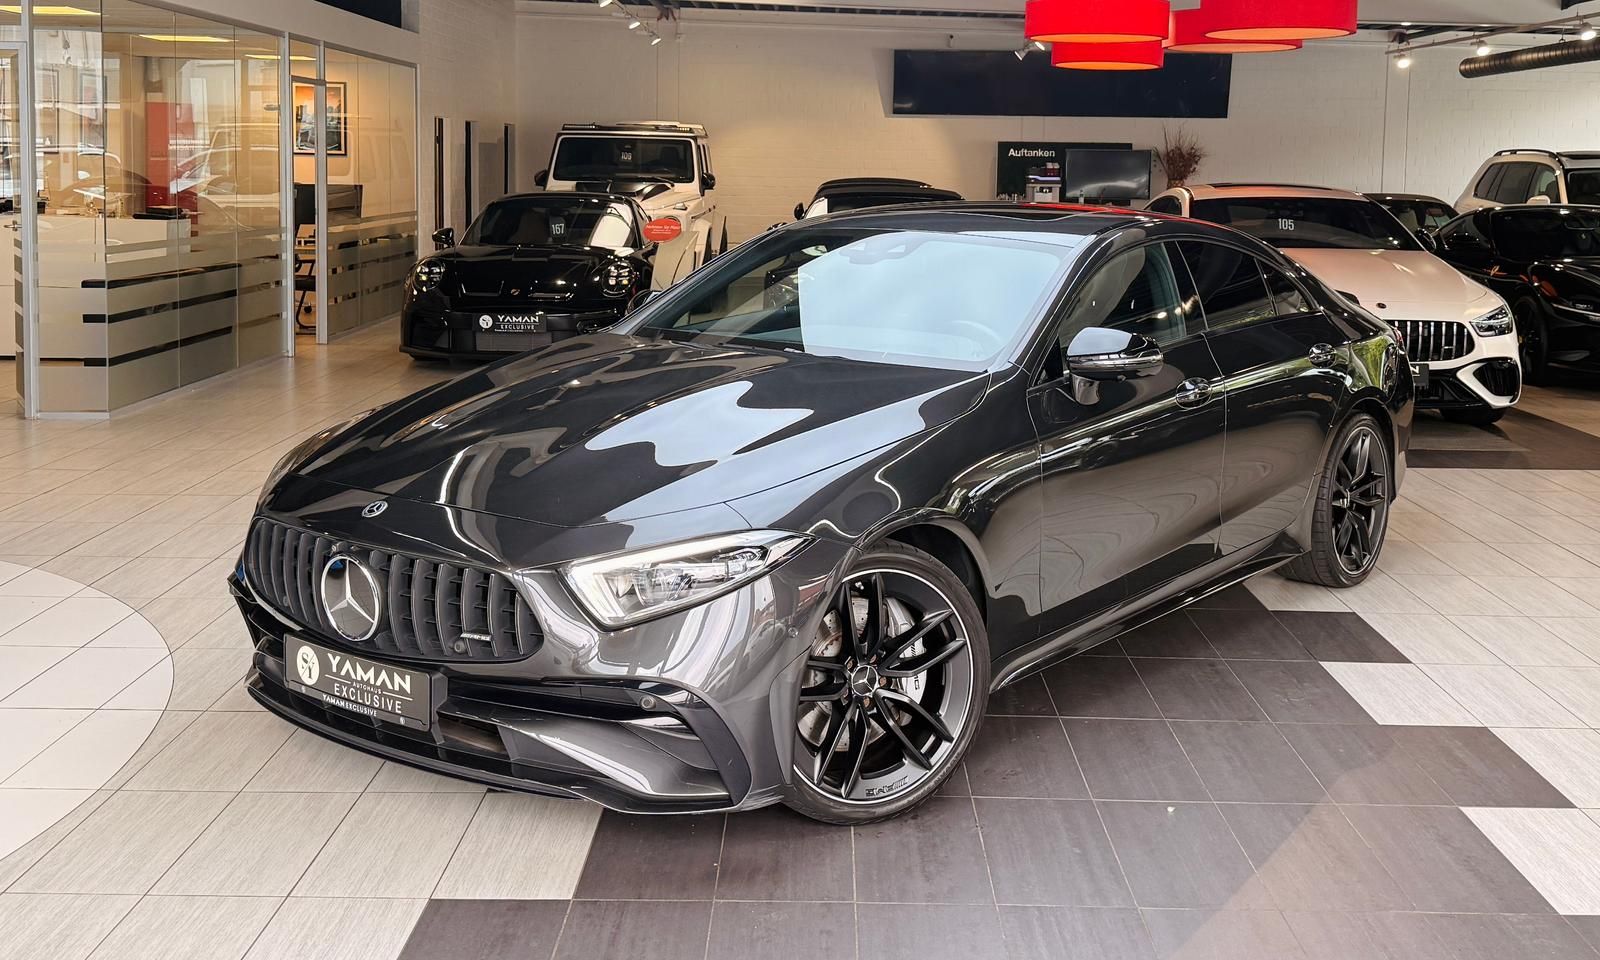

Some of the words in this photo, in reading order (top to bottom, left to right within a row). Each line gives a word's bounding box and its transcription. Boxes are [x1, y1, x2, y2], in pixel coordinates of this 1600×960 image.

[1008, 148, 1055, 157] Auftanken
[552, 223, 565, 234] 167
[1278, 218, 1294, 230] 105
[327, 652, 411, 694] YAMAN
[352, 681, 382, 694] AUTOHAUS
[334, 683, 402, 713] EXCLUSIVE
